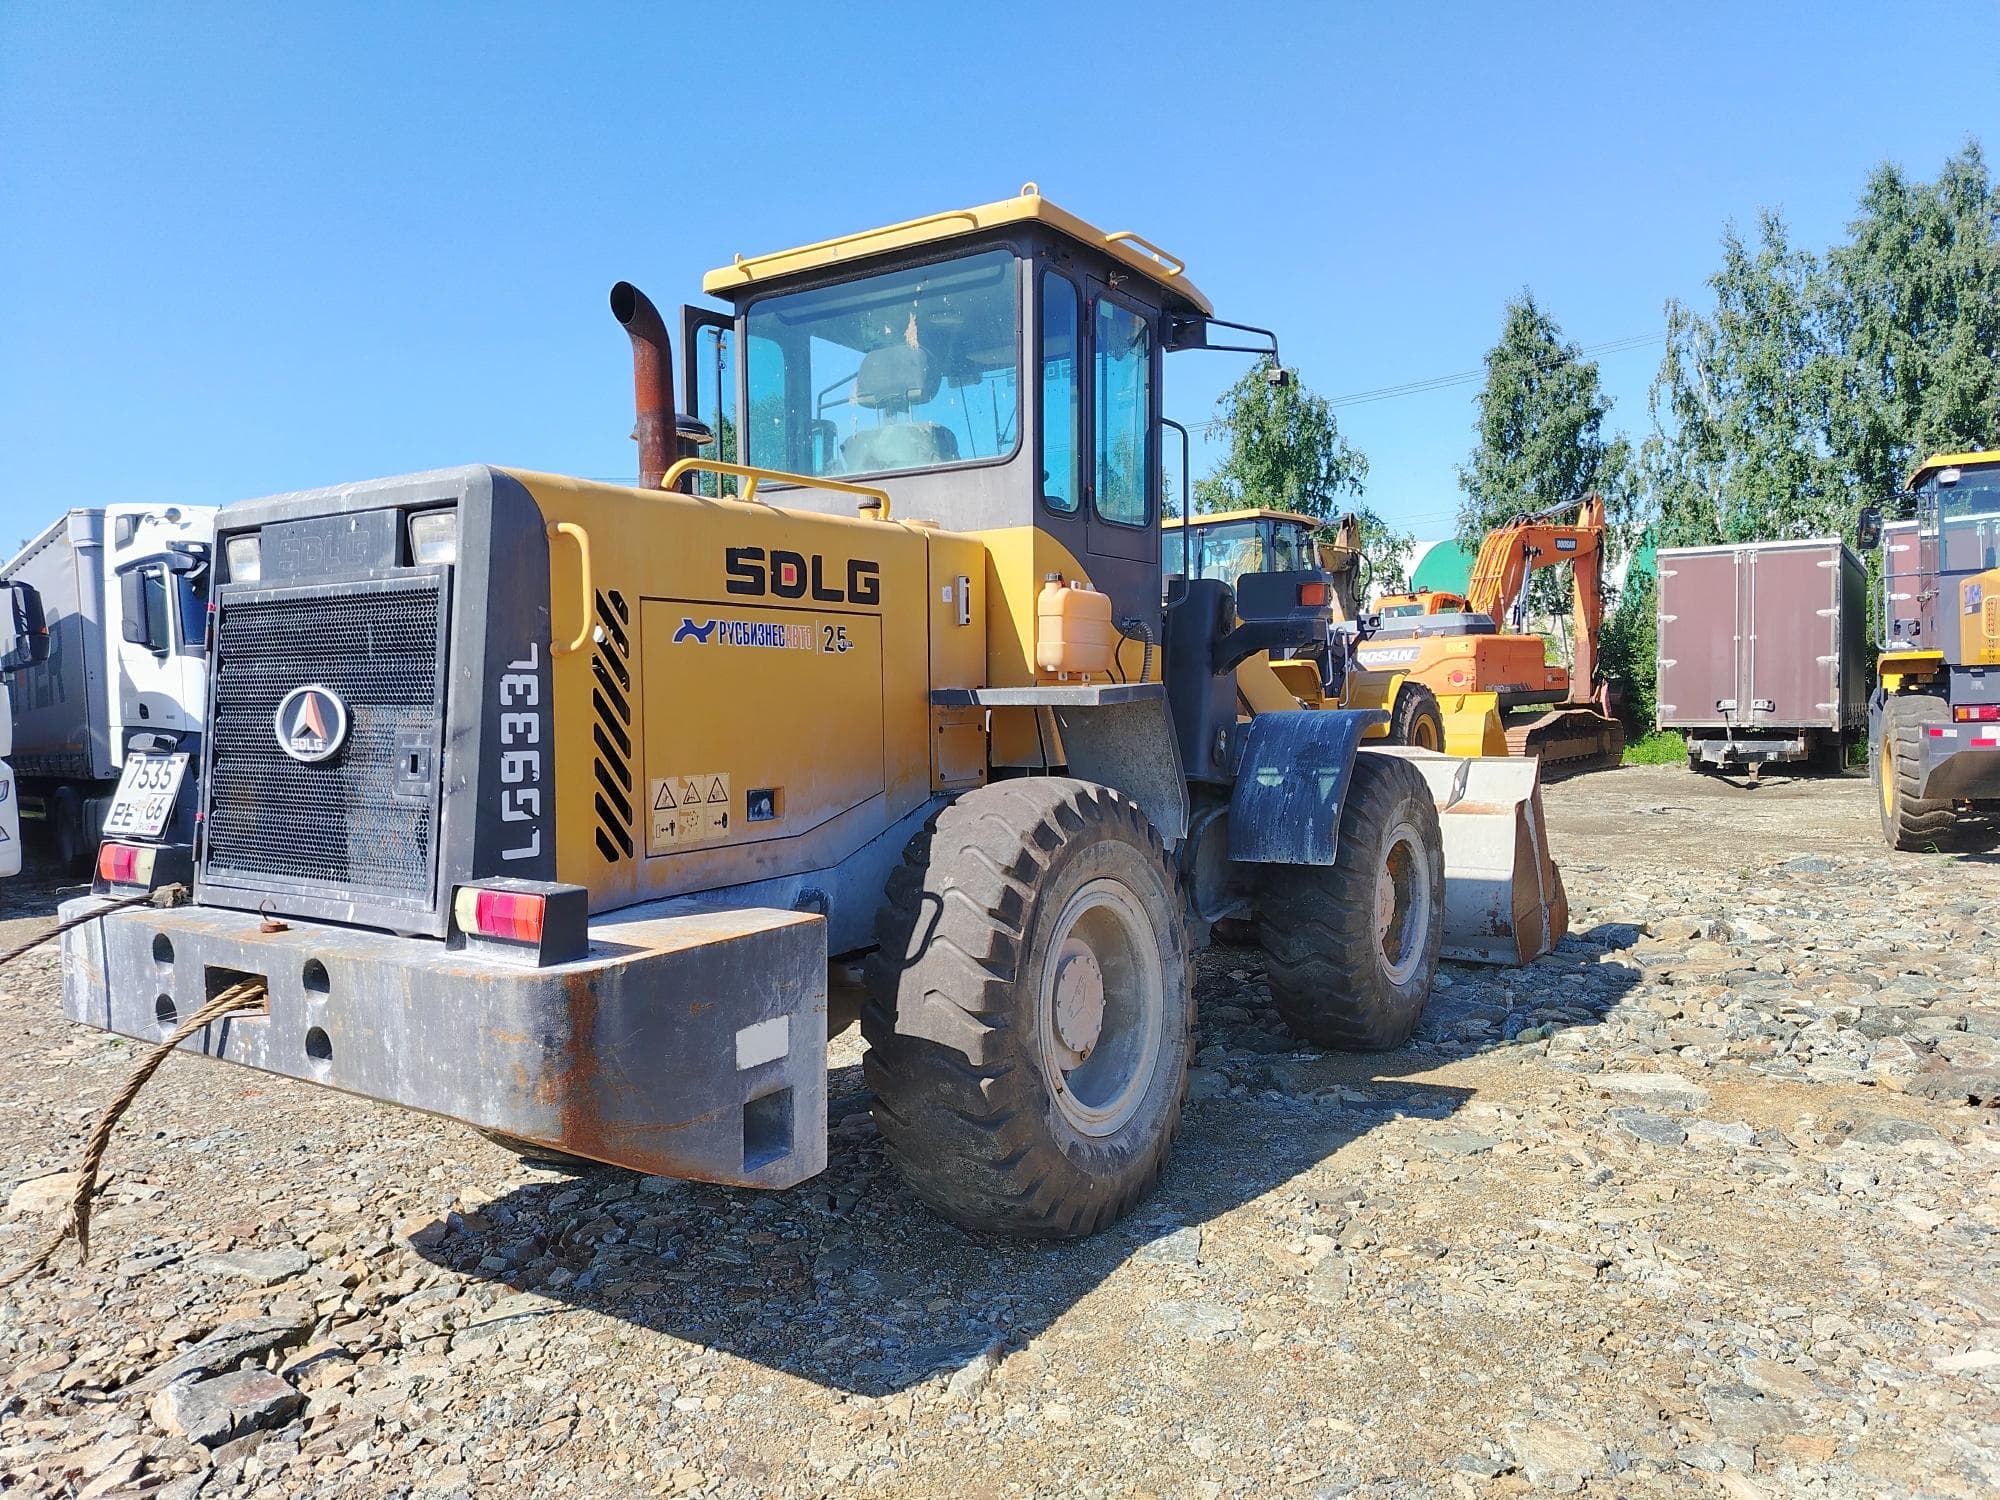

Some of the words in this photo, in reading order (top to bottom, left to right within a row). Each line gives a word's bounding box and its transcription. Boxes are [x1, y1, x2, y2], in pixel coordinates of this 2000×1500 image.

[727, 546, 880, 606] SDLG
[718, 620, 813, 650] РУСБИЗНЕСАВТО
[290, 738, 323, 751] SDLG
[500, 642, 541, 860] LG933L
[128, 759, 176, 790] 7535
[145, 797, 166, 820] 66
